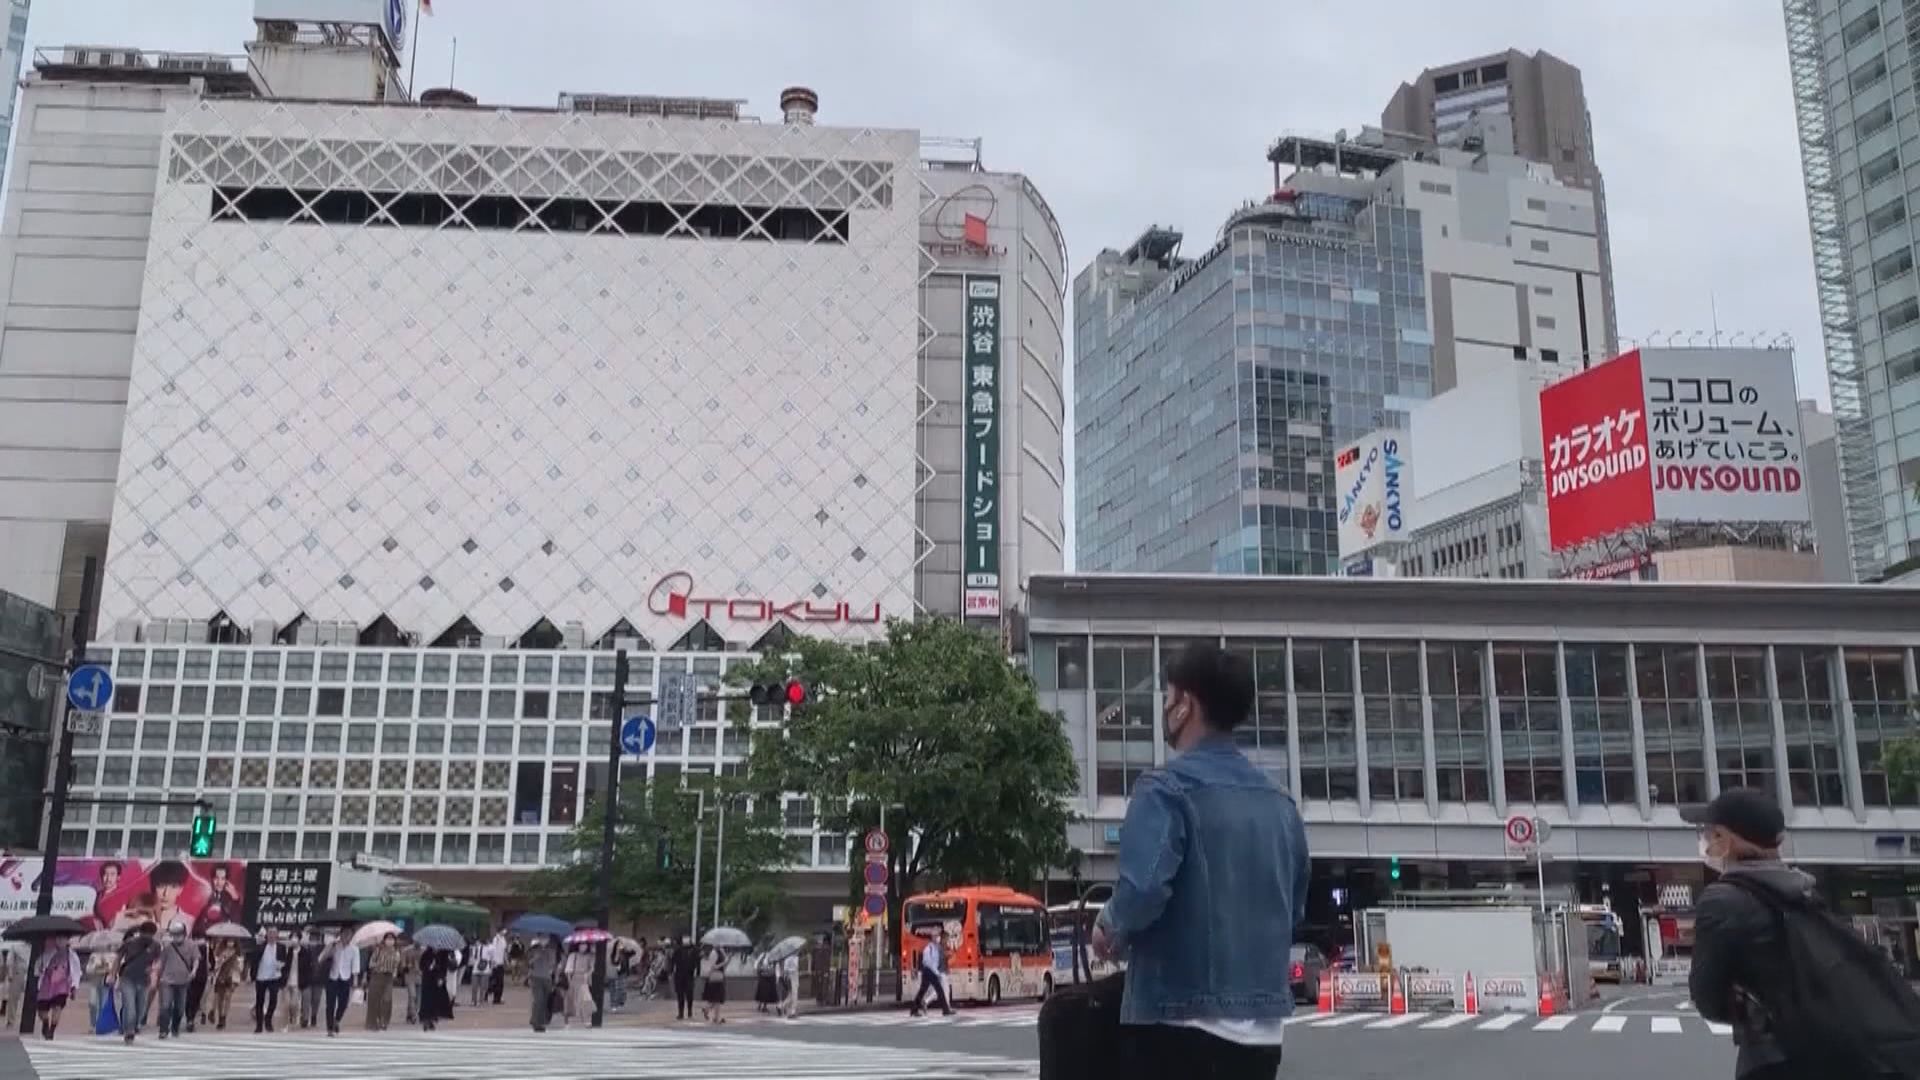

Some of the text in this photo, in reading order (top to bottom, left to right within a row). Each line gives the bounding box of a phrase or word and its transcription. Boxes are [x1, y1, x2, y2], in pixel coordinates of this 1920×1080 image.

[972, 305, 995, 354] 渋谷
[1649, 377, 1759, 405] ココロの
[1652, 406, 1795, 437] ボリューム、
[1549, 408, 1641, 470] カラオケ
[1655, 439, 1799, 462] あげていこう。
[971, 364, 994, 568] 東急フードショー
[1551, 443, 1647, 498] JOYSOUND
[1655, 464, 1802, 493] JOYSOUND
[1339, 447, 1378, 525] SANKYO
[1383, 439, 1405, 531] SANKYO
[1594, 558, 1635, 578] JOYSOUND
[689, 598, 881, 624] TOKYU
[967, 594, 998, 610] 営業中
[259, 867, 318, 883] 毎週土曜
